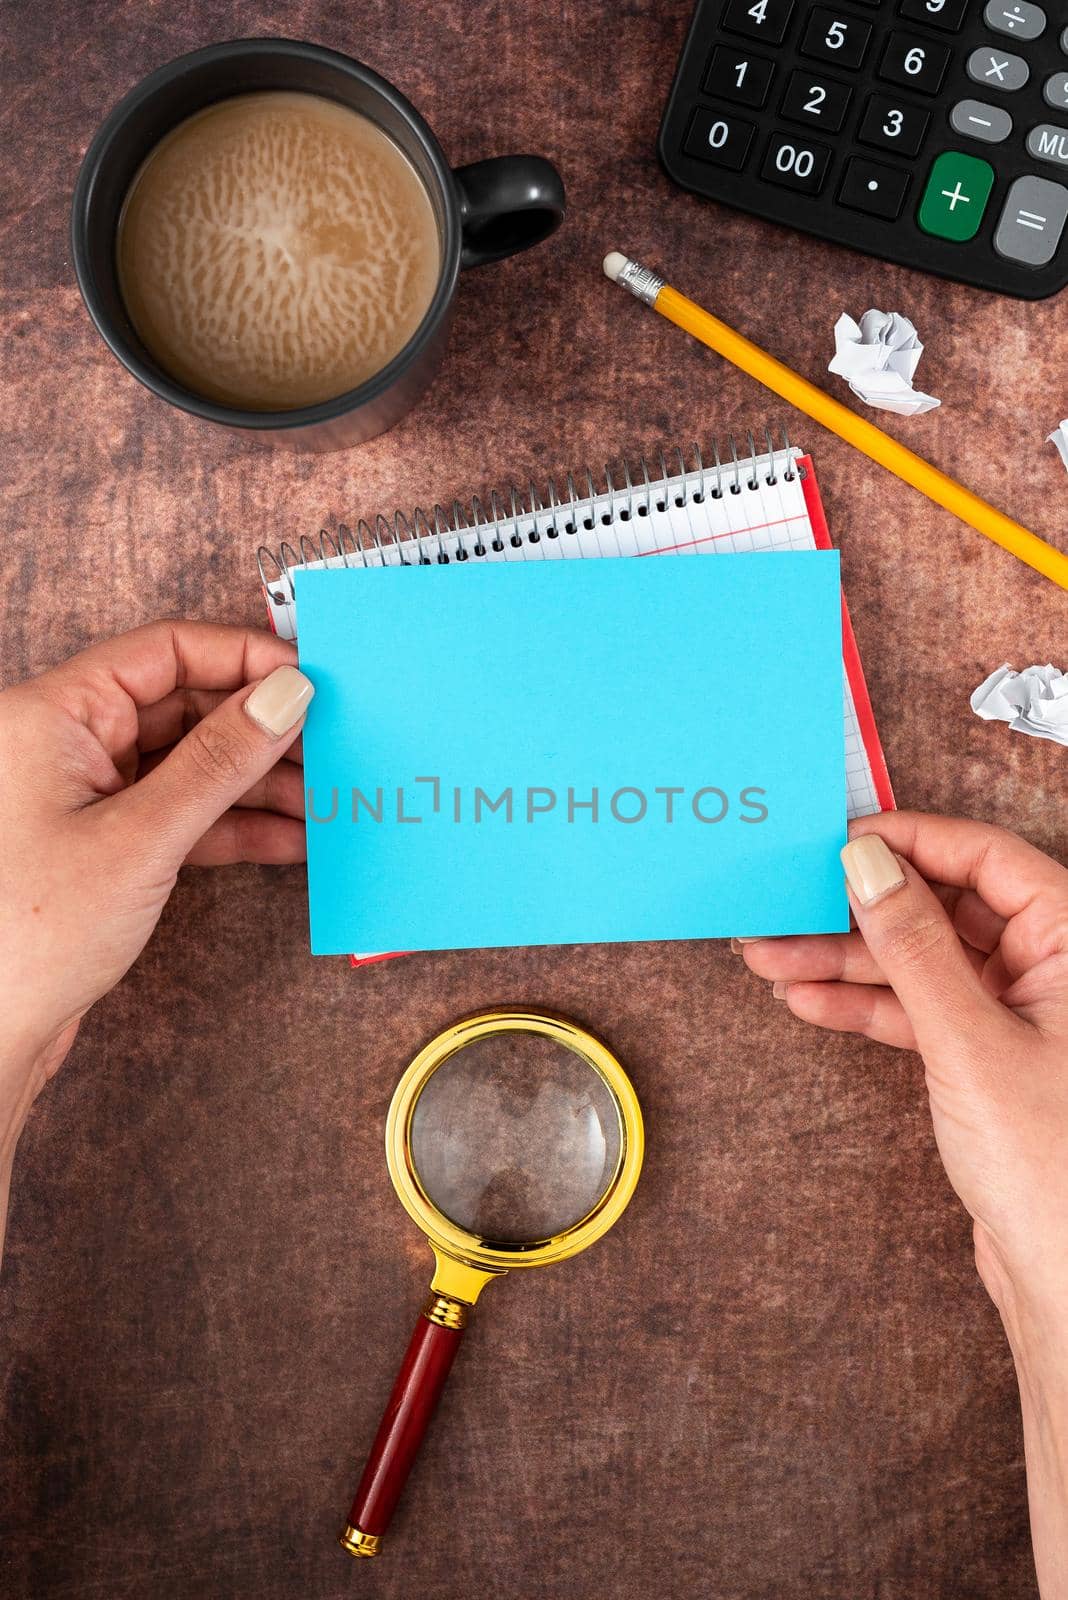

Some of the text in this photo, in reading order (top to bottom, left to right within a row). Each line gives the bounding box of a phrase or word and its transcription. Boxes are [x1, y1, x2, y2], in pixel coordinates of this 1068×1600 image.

[748, 0, 769, 24] 4
[825, 21, 848, 49] 5
[735, 61, 748, 87] 1
[904, 47, 926, 75] 6
[803, 86, 826, 114] 2
[708, 121, 729, 148] 0
[883, 109, 904, 137] 3
[776, 145, 814, 177] 00
